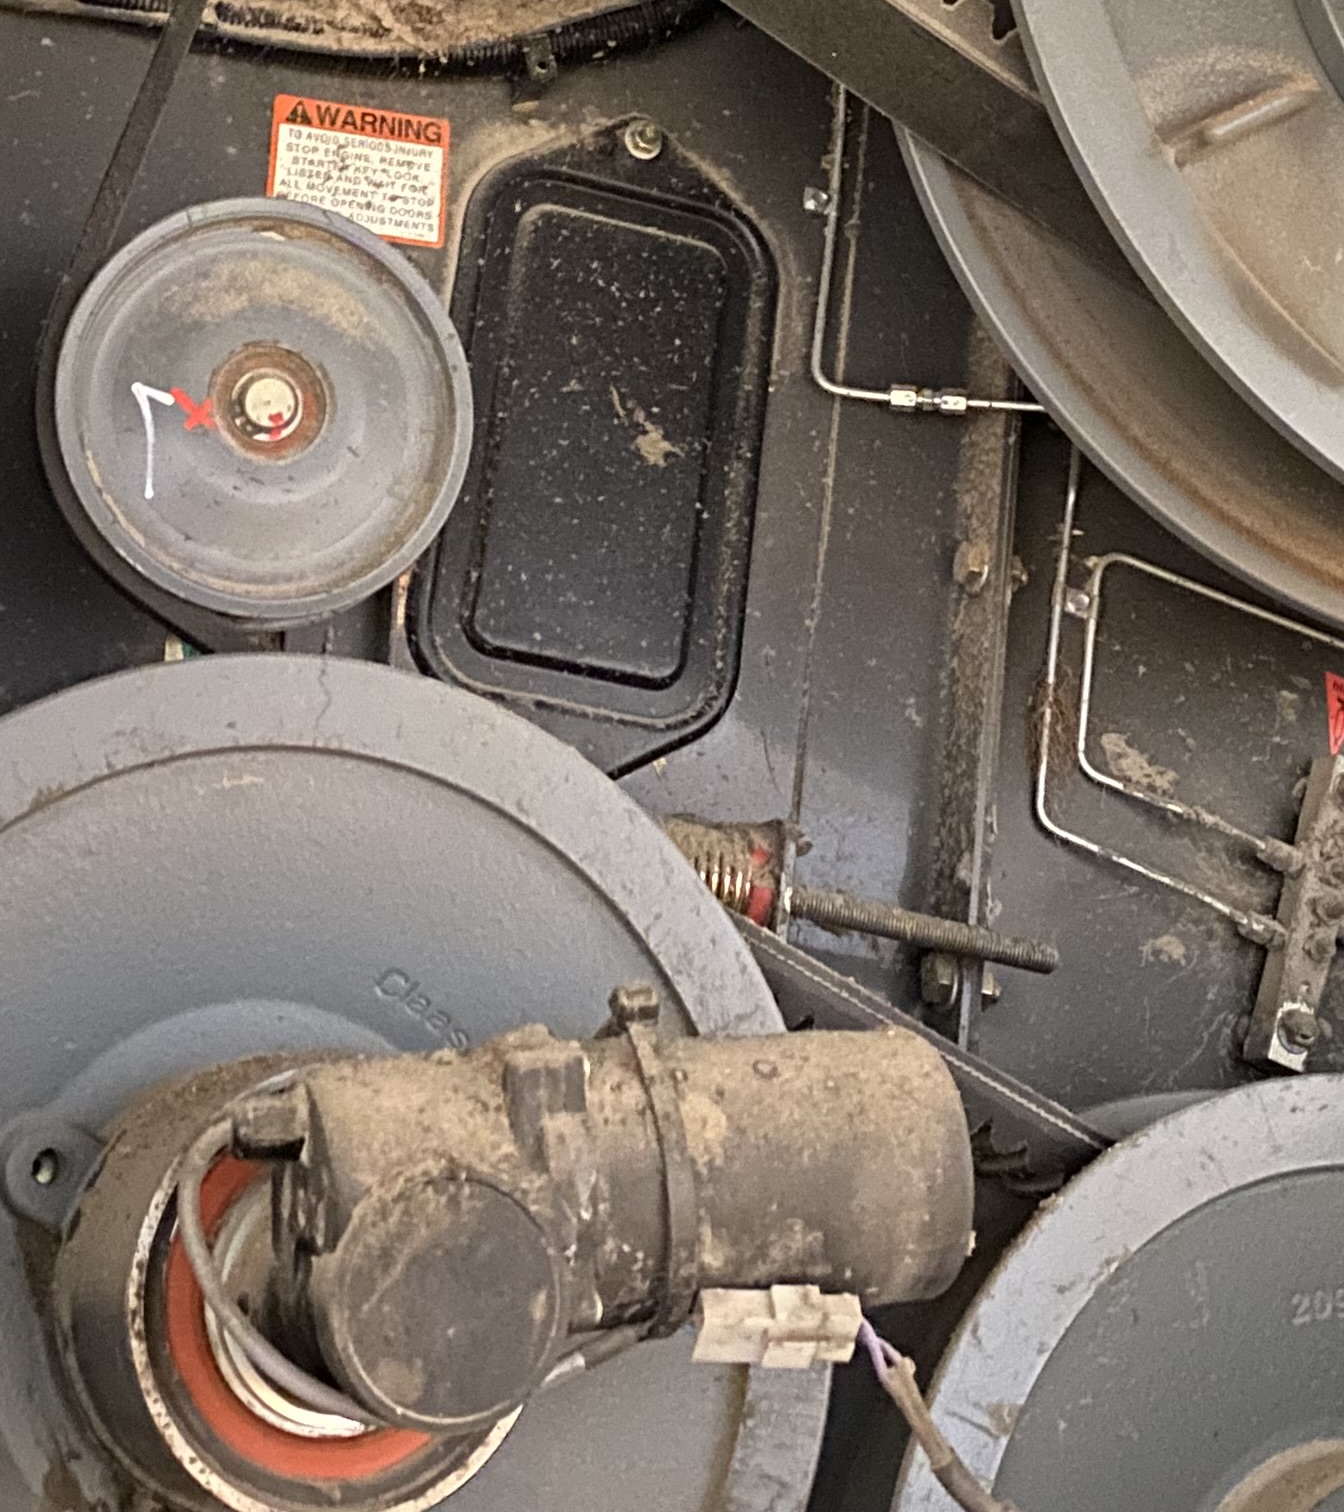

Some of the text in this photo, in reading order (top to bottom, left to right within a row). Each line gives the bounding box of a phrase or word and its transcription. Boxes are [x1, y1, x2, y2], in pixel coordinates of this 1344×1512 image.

[314, 104, 444, 143] WARNING
[286, 142, 319, 156] STOP
[379, 156, 431, 172] REMOVE
[288, 128, 433, 159] TO AVOID SERIOUS INJURY
[279, 178, 302, 189] ALL
[306, 181, 378, 200] MOVEMENT
[402, 195, 435, 208] STOP
[336, 174, 362, 186] AND
[401, 183, 428, 195] FOR
[389, 206, 433, 220] DOORS
